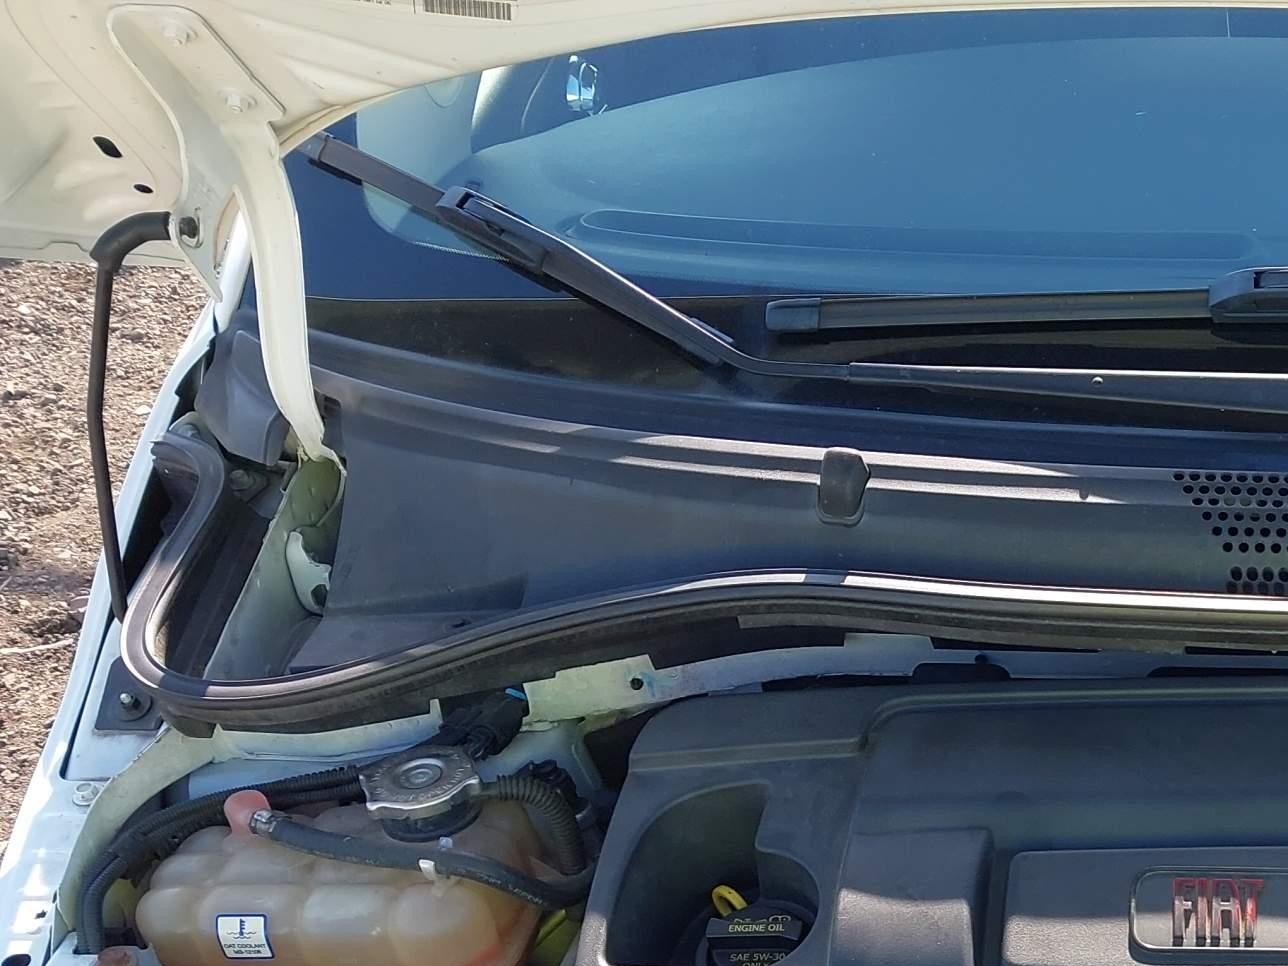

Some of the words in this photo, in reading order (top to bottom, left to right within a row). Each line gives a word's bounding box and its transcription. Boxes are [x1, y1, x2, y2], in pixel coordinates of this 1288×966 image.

[1172, 878, 1264, 947] FIAT
[728, 923, 766, 933] ENGINE
[767, 923, 785, 932] OIL
[730, 953, 750, 962] SAE
[752, 952, 786, 961] 5W-30
